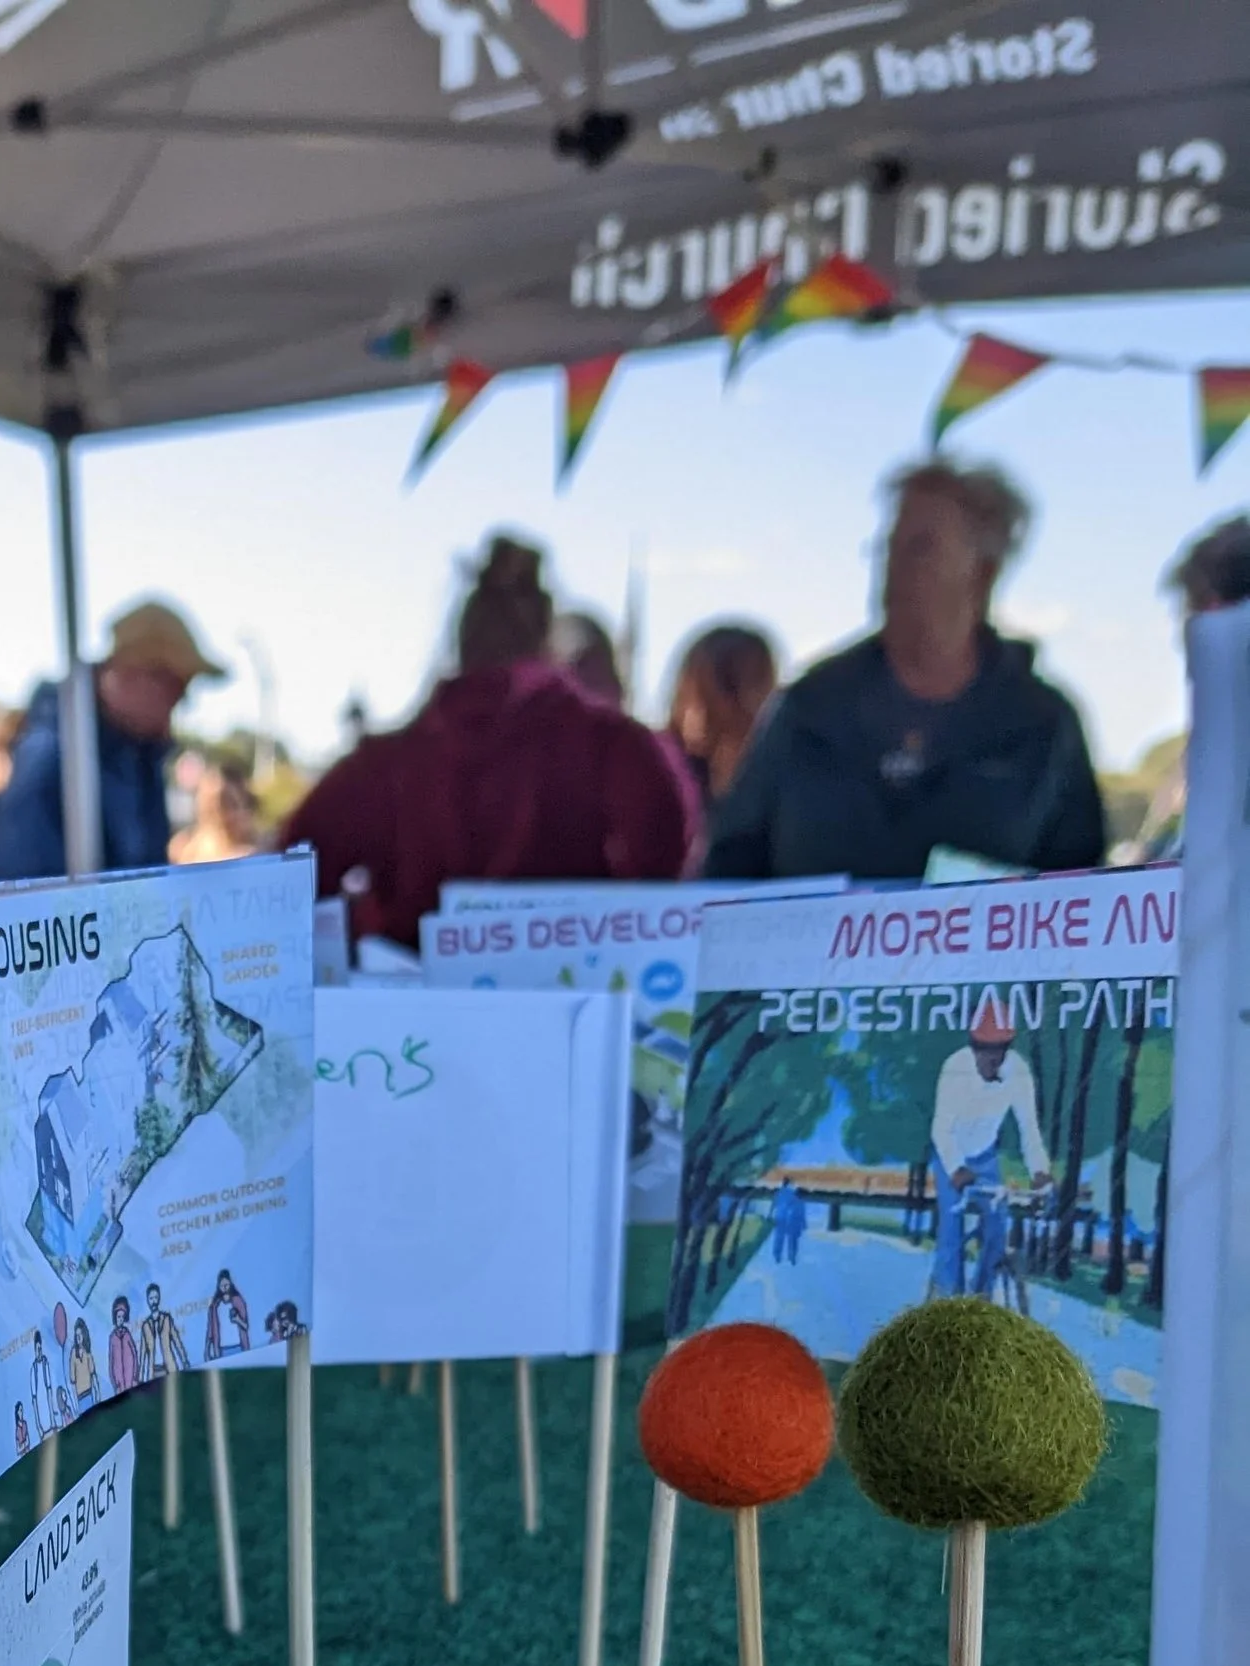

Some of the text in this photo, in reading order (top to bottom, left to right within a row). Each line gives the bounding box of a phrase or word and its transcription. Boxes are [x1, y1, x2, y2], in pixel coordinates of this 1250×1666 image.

[436, 922, 514, 956] BUS
[828, 905, 972, 960] MORE
[986, 896, 1092, 952] BIKE
[1102, 890, 1178, 948] AN
[757, 976, 1177, 1035] PEDESTRIAN PATH
[157, 1189, 219, 1219] COMMON
[25, 1462, 117, 1603] LAND BACK
